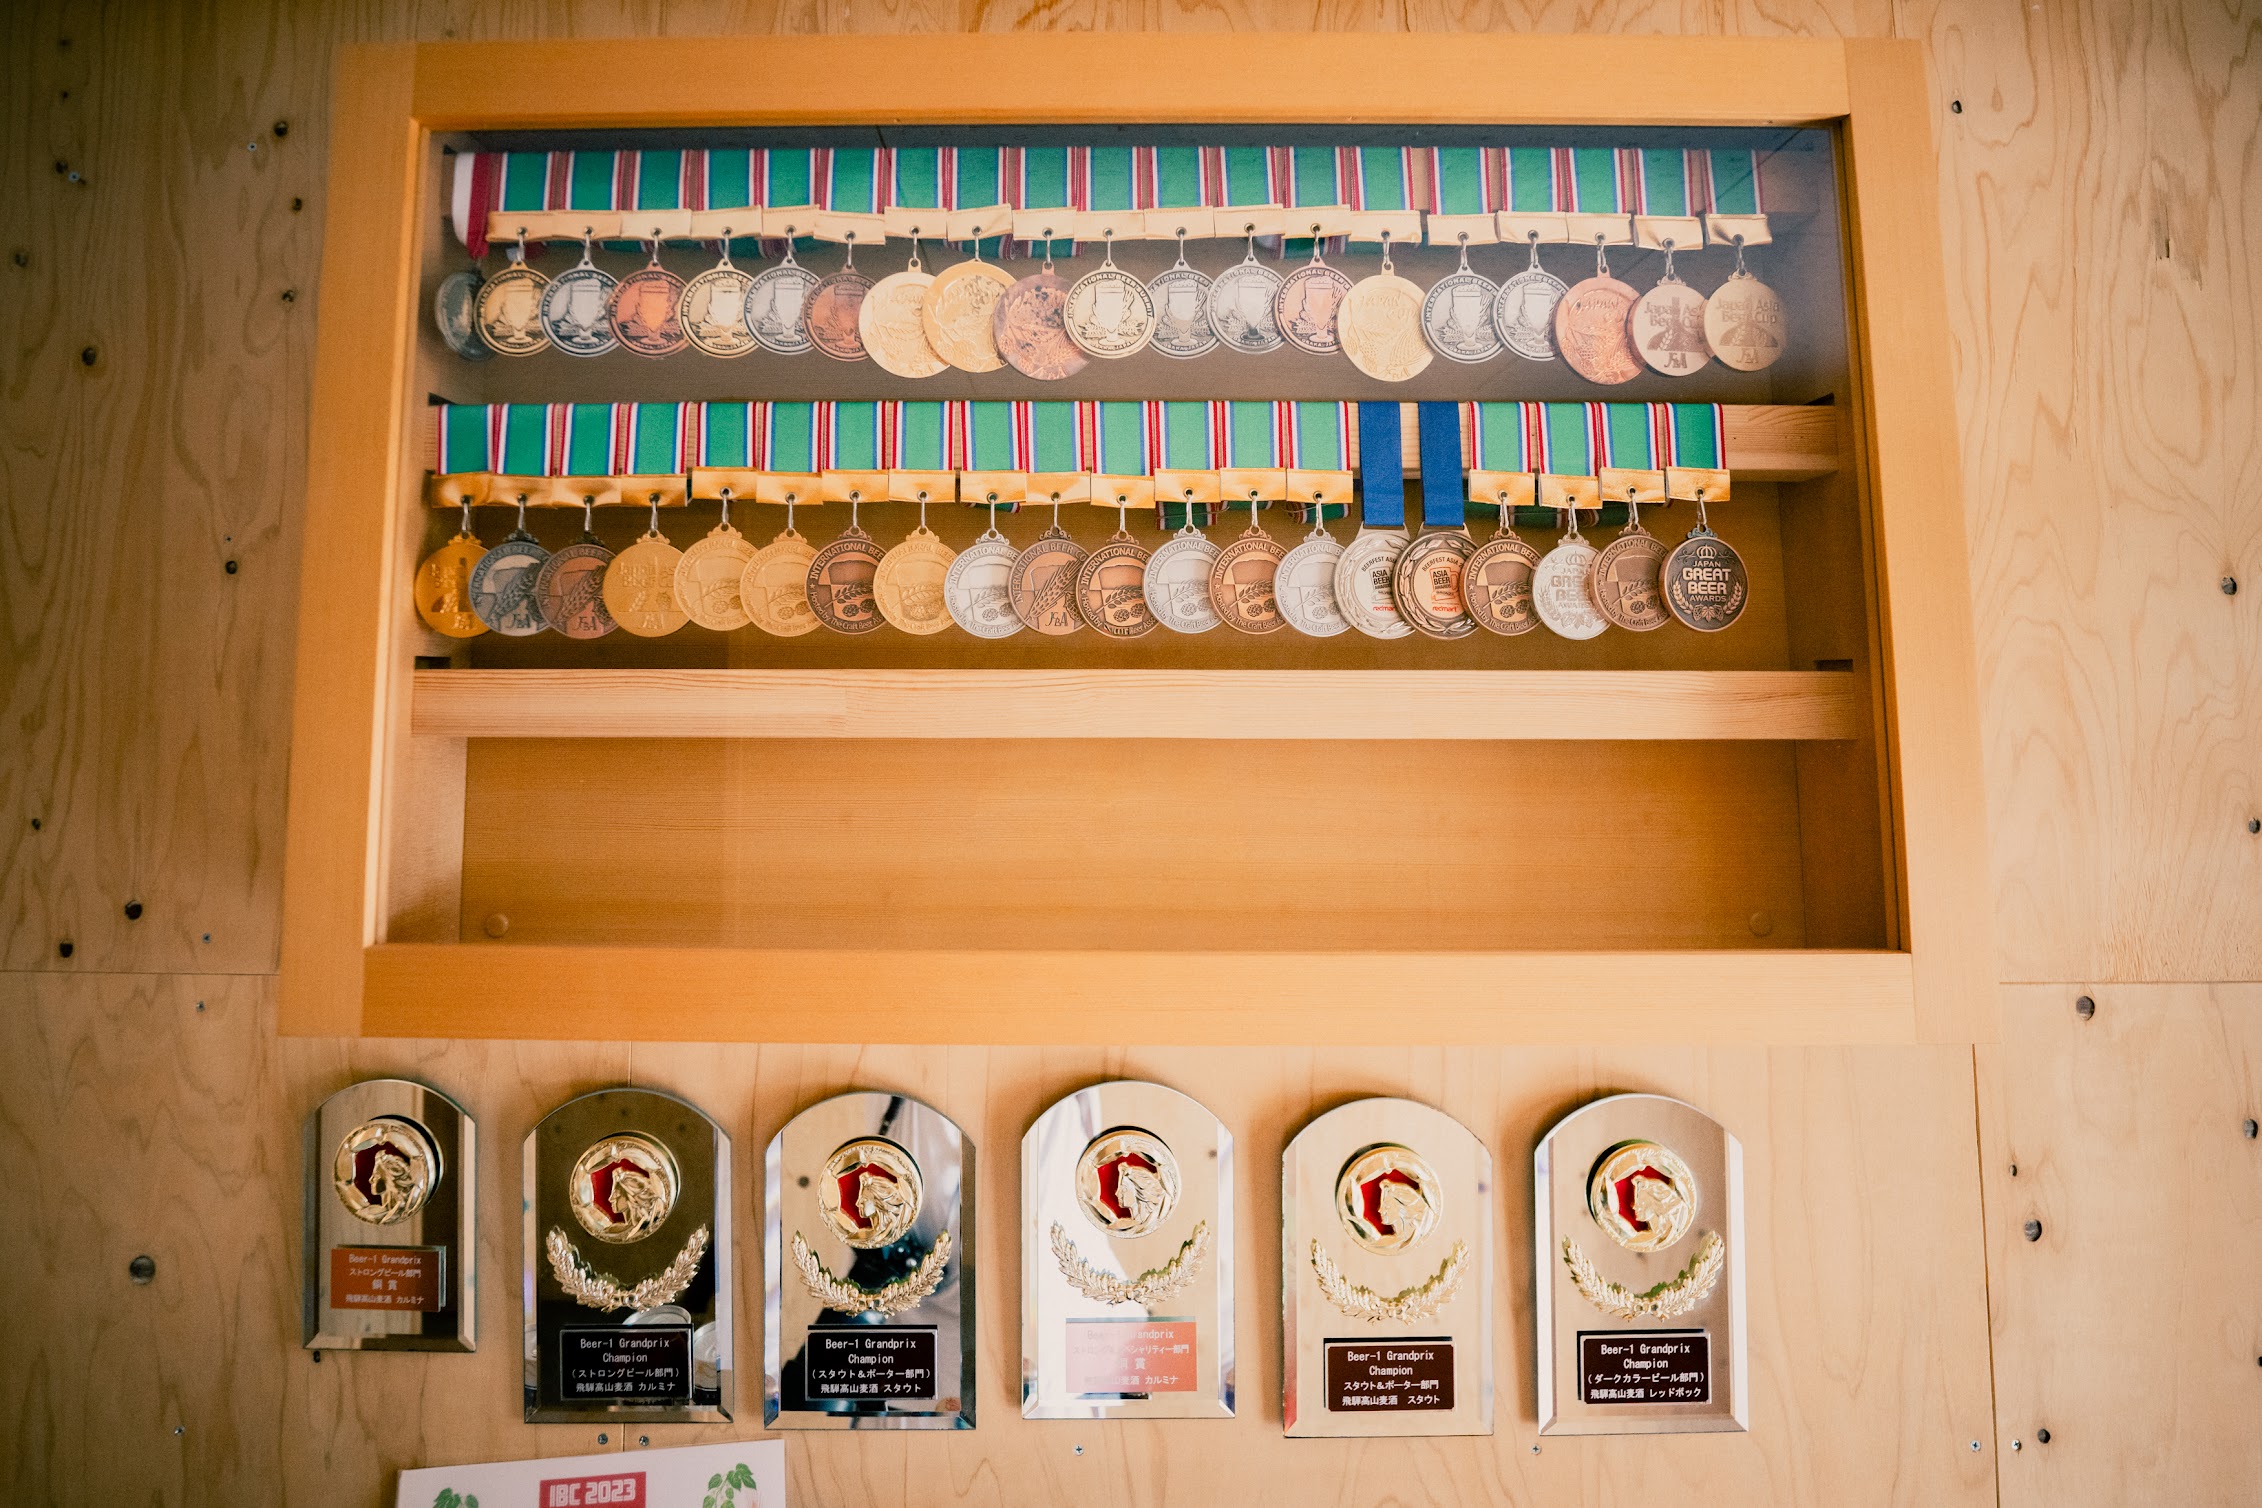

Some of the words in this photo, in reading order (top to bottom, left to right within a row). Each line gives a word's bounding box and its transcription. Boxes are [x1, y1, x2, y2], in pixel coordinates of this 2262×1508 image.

[1189, 273, 1211, 287] BEER
[1257, 268, 1279, 282] BEER
[1543, 276, 1564, 290] BEER
[682, 272, 727, 315] INTERNATIONAL
[1067, 273, 1112, 316] INTERNATIONAL
[1115, 273, 1136, 287] BEER
[1135, 285, 1152, 317] SUMMIT
[1278, 268, 1321, 311] INTERNATIONAL
[1324, 270, 1345, 283] BEER
[1425, 275, 1469, 320] INTERNATIONAL
[1472, 277, 1494, 291] BEER
[1644, 302, 1676, 314] Japa
[1756, 299, 1779, 311] Asia
[1650, 315, 1674, 326] Bee
[1755, 312, 1777, 325] Cup
[1473, 343, 1492, 354] JAPAN
[802, 547, 816, 559] BE
[935, 545, 959, 564] BEER
[1147, 540, 1204, 578] INTERNATIONAL
[1203, 543, 1220, 558] BEE
[1597, 537, 1652, 576] INTERNATIONAL
[1650, 540, 1669, 556] BEE
[809, 541, 867, 579] INTERNATIONAL
[867, 545, 885, 560] BEE
[947, 546, 1005, 583] INTERNATIONAL
[1005, 549, 1018, 561] BE
[1079, 545, 1136, 584] INTERNATIONAL
[1136, 549, 1150, 561] BE
[1213, 540, 1269, 579] INTERNATIONAL
[1269, 544, 1287, 559] BEE
[1278, 543, 1334, 582] INTERNATIONAL
[1361, 556, 1385, 572] BEERFEST
[1385, 556, 1397, 564] ASI
[1421, 556, 1445, 572] BEERFEST
[1447, 557, 1459, 566] ASIA
[1467, 542, 1520, 580] INTERNATIONAL
[1519, 546, 1542, 564] BEER
[1692, 560, 1721, 568] JAPAN
[1015, 545, 1048, 604] INTERNATIONAL
[1049, 542, 1074, 554] BEER
[1372, 569, 1387, 578] ASIA
[1433, 570, 1447, 578] ASIA
[1682, 567, 1732, 581] GREAT
[1373, 576, 1391, 585] BEER
[1434, 576, 1451, 585] BEER
[1550, 575, 1582, 587] GRE
[1687, 582, 1727, 595] BEER
[1148, 591, 1164, 615] Hosted
[809, 591, 825, 615] Hosted
[820, 611, 831, 623] by
[829, 616, 843, 628] The
[841, 620, 857, 631] Craft
[858, 618, 873, 630] Beer
[1080, 597, 1097, 620] Hosted
[1091, 616, 1103, 628] by
[1214, 591, 1231, 616] Hosted
[1225, 611, 1237, 622] by
[1234, 615, 1247, 627] The
[1246, 619, 1262, 630] Craft
[1262, 618, 1277, 629] Beer
[1468, 592, 1483, 616] Hosted
[1478, 613, 1489, 623] by
[1487, 618, 1500, 629] The
[1499, 622, 1513, 631] Craft
[348, 1254, 377, 1263] Beer-1
[382, 1255, 422, 1265] Grandprix
[349, 1268, 422, 1278] ストロングビール部門
[396, 1295, 424, 1304] カルミナ
[1129, 1329, 1174, 1340] andprix
[580, 1338, 613, 1349] Beer-1
[619, 1337, 670, 1349] Grandprix
[826, 1338, 859, 1349] Beer-1
[864, 1338, 916, 1350] Grandprix
[1600, 1344, 1634, 1355] Beer-1
[1640, 1343, 1690, 1355] Grandprix
[602, 1352, 648, 1363] Champion
[848, 1353, 894, 1364] Champion
[1348, 1351, 1381, 1362] Beer-1
[1386, 1350, 1434, 1362] Grandprix
[1135, 1358, 1146, 1370] 賞
[1623, 1358, 1668, 1370] Champion
[572, 1368, 680, 1378] （ストロングビール部門）
[1369, 1365, 1413, 1376] Champion
[1145, 1376, 1178, 1385] カルミナ
[576, 1382, 633, 1392] 飛騨高山麦酒
[638, 1382, 676, 1392] カルミナ
[820, 1383, 878, 1394] 飛騨高山麦酒
[884, 1384, 922, 1393] スタウト
[1590, 1388, 1644, 1400] 飛騨高山麦酒
[1650, 1387, 1702, 1398] レッドボック
[1342, 1395, 1398, 1406] 飛騨高山麦酒
[1407, 1394, 1440, 1404] スタウト
[549, 1482, 581, 1508] IBC
[585, 1478, 636, 1505] 2023
